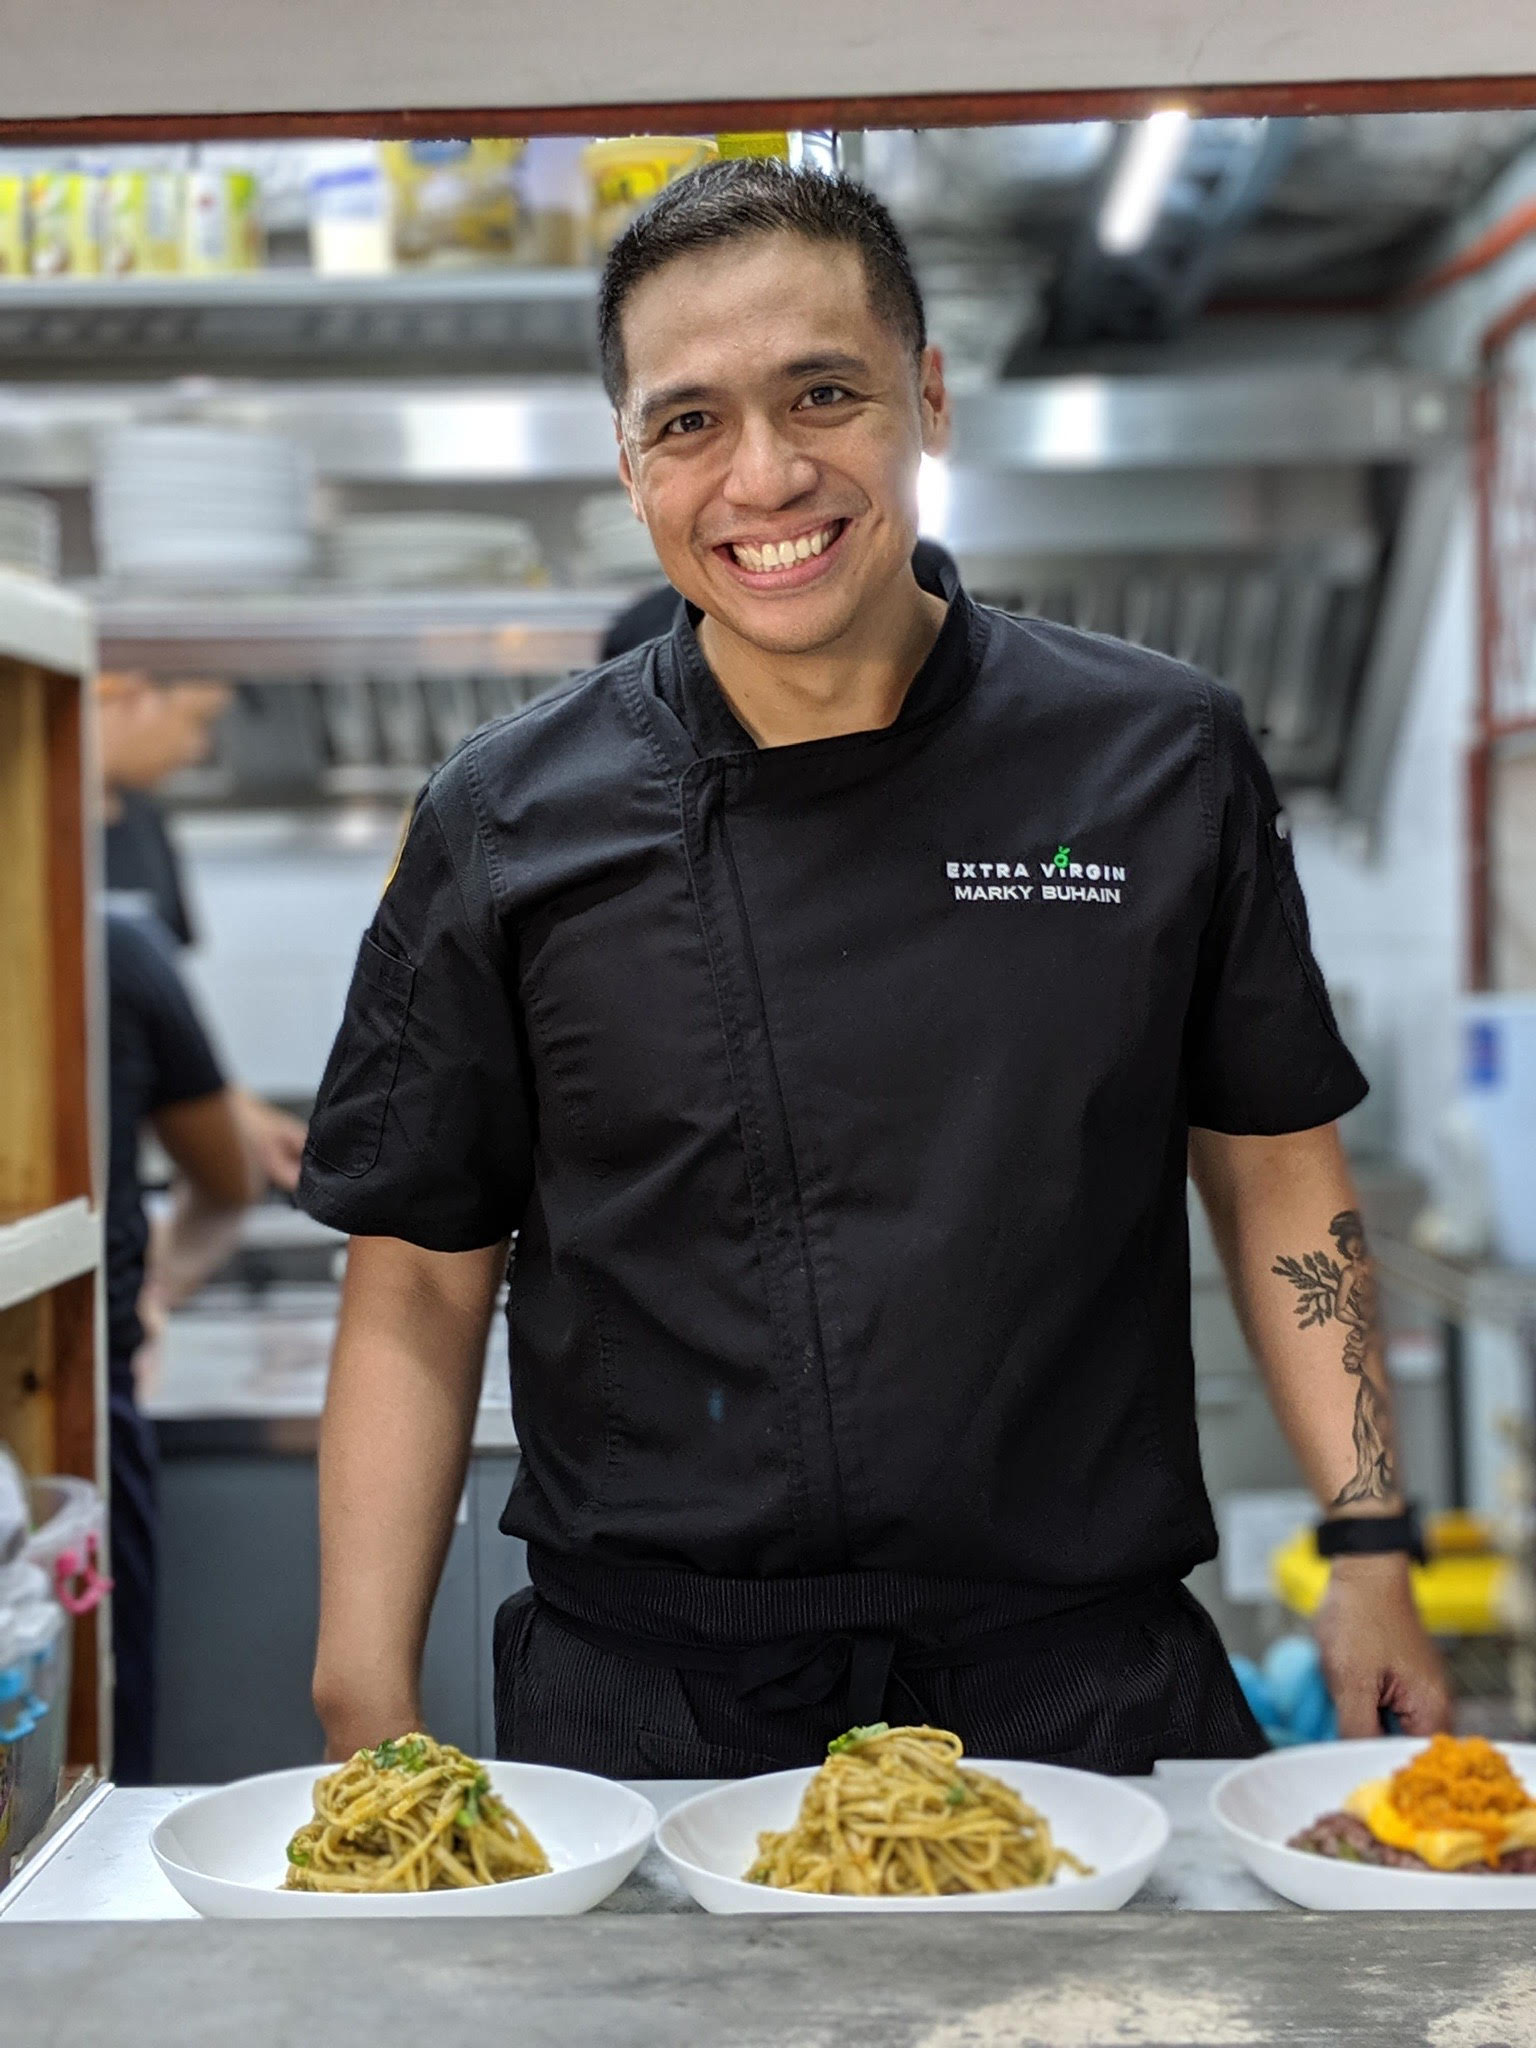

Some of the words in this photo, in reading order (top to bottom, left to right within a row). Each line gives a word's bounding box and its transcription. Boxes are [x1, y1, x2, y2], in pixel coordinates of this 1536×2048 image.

[946, 861, 1030, 879] EXTRA
[954, 885, 1034, 900] MARKY
[1041, 885, 1121, 903] BUHAIN
